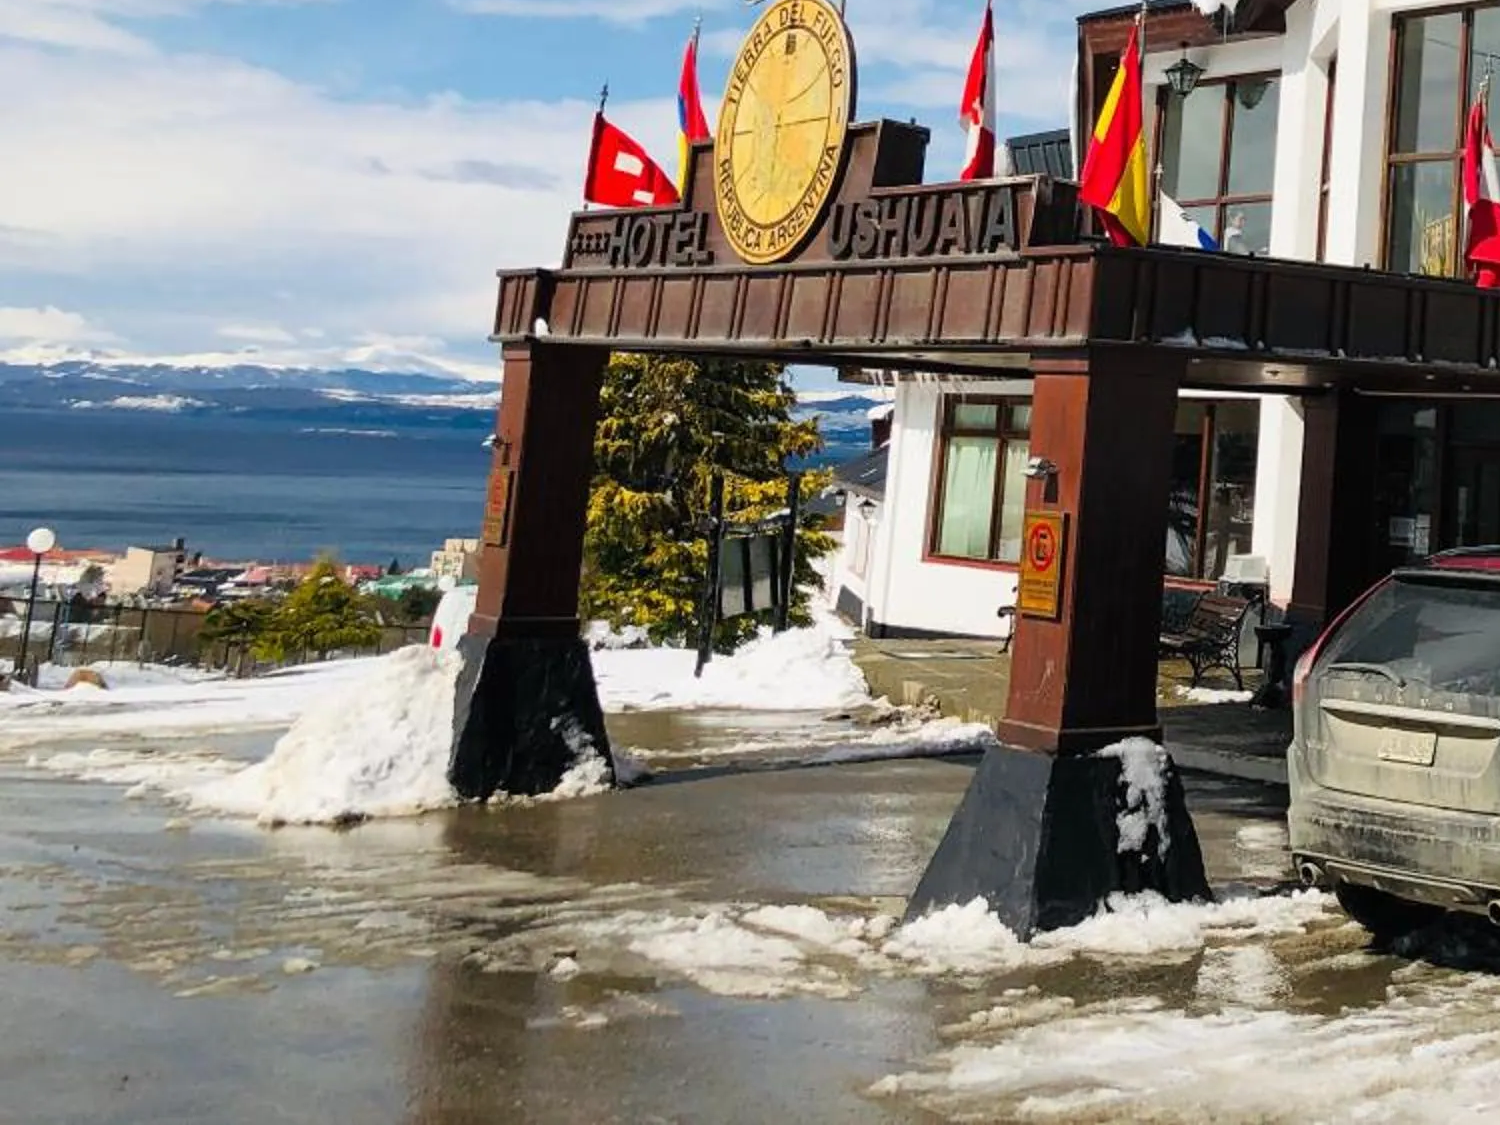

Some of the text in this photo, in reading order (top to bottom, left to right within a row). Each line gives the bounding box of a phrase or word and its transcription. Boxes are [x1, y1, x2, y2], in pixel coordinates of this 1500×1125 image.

[728, 2, 843, 104] TIERRA DEL FUEGO
[610, 187, 1026, 268] HOTEL USHUAIA
[766, 145, 838, 250] ARGENTINA
